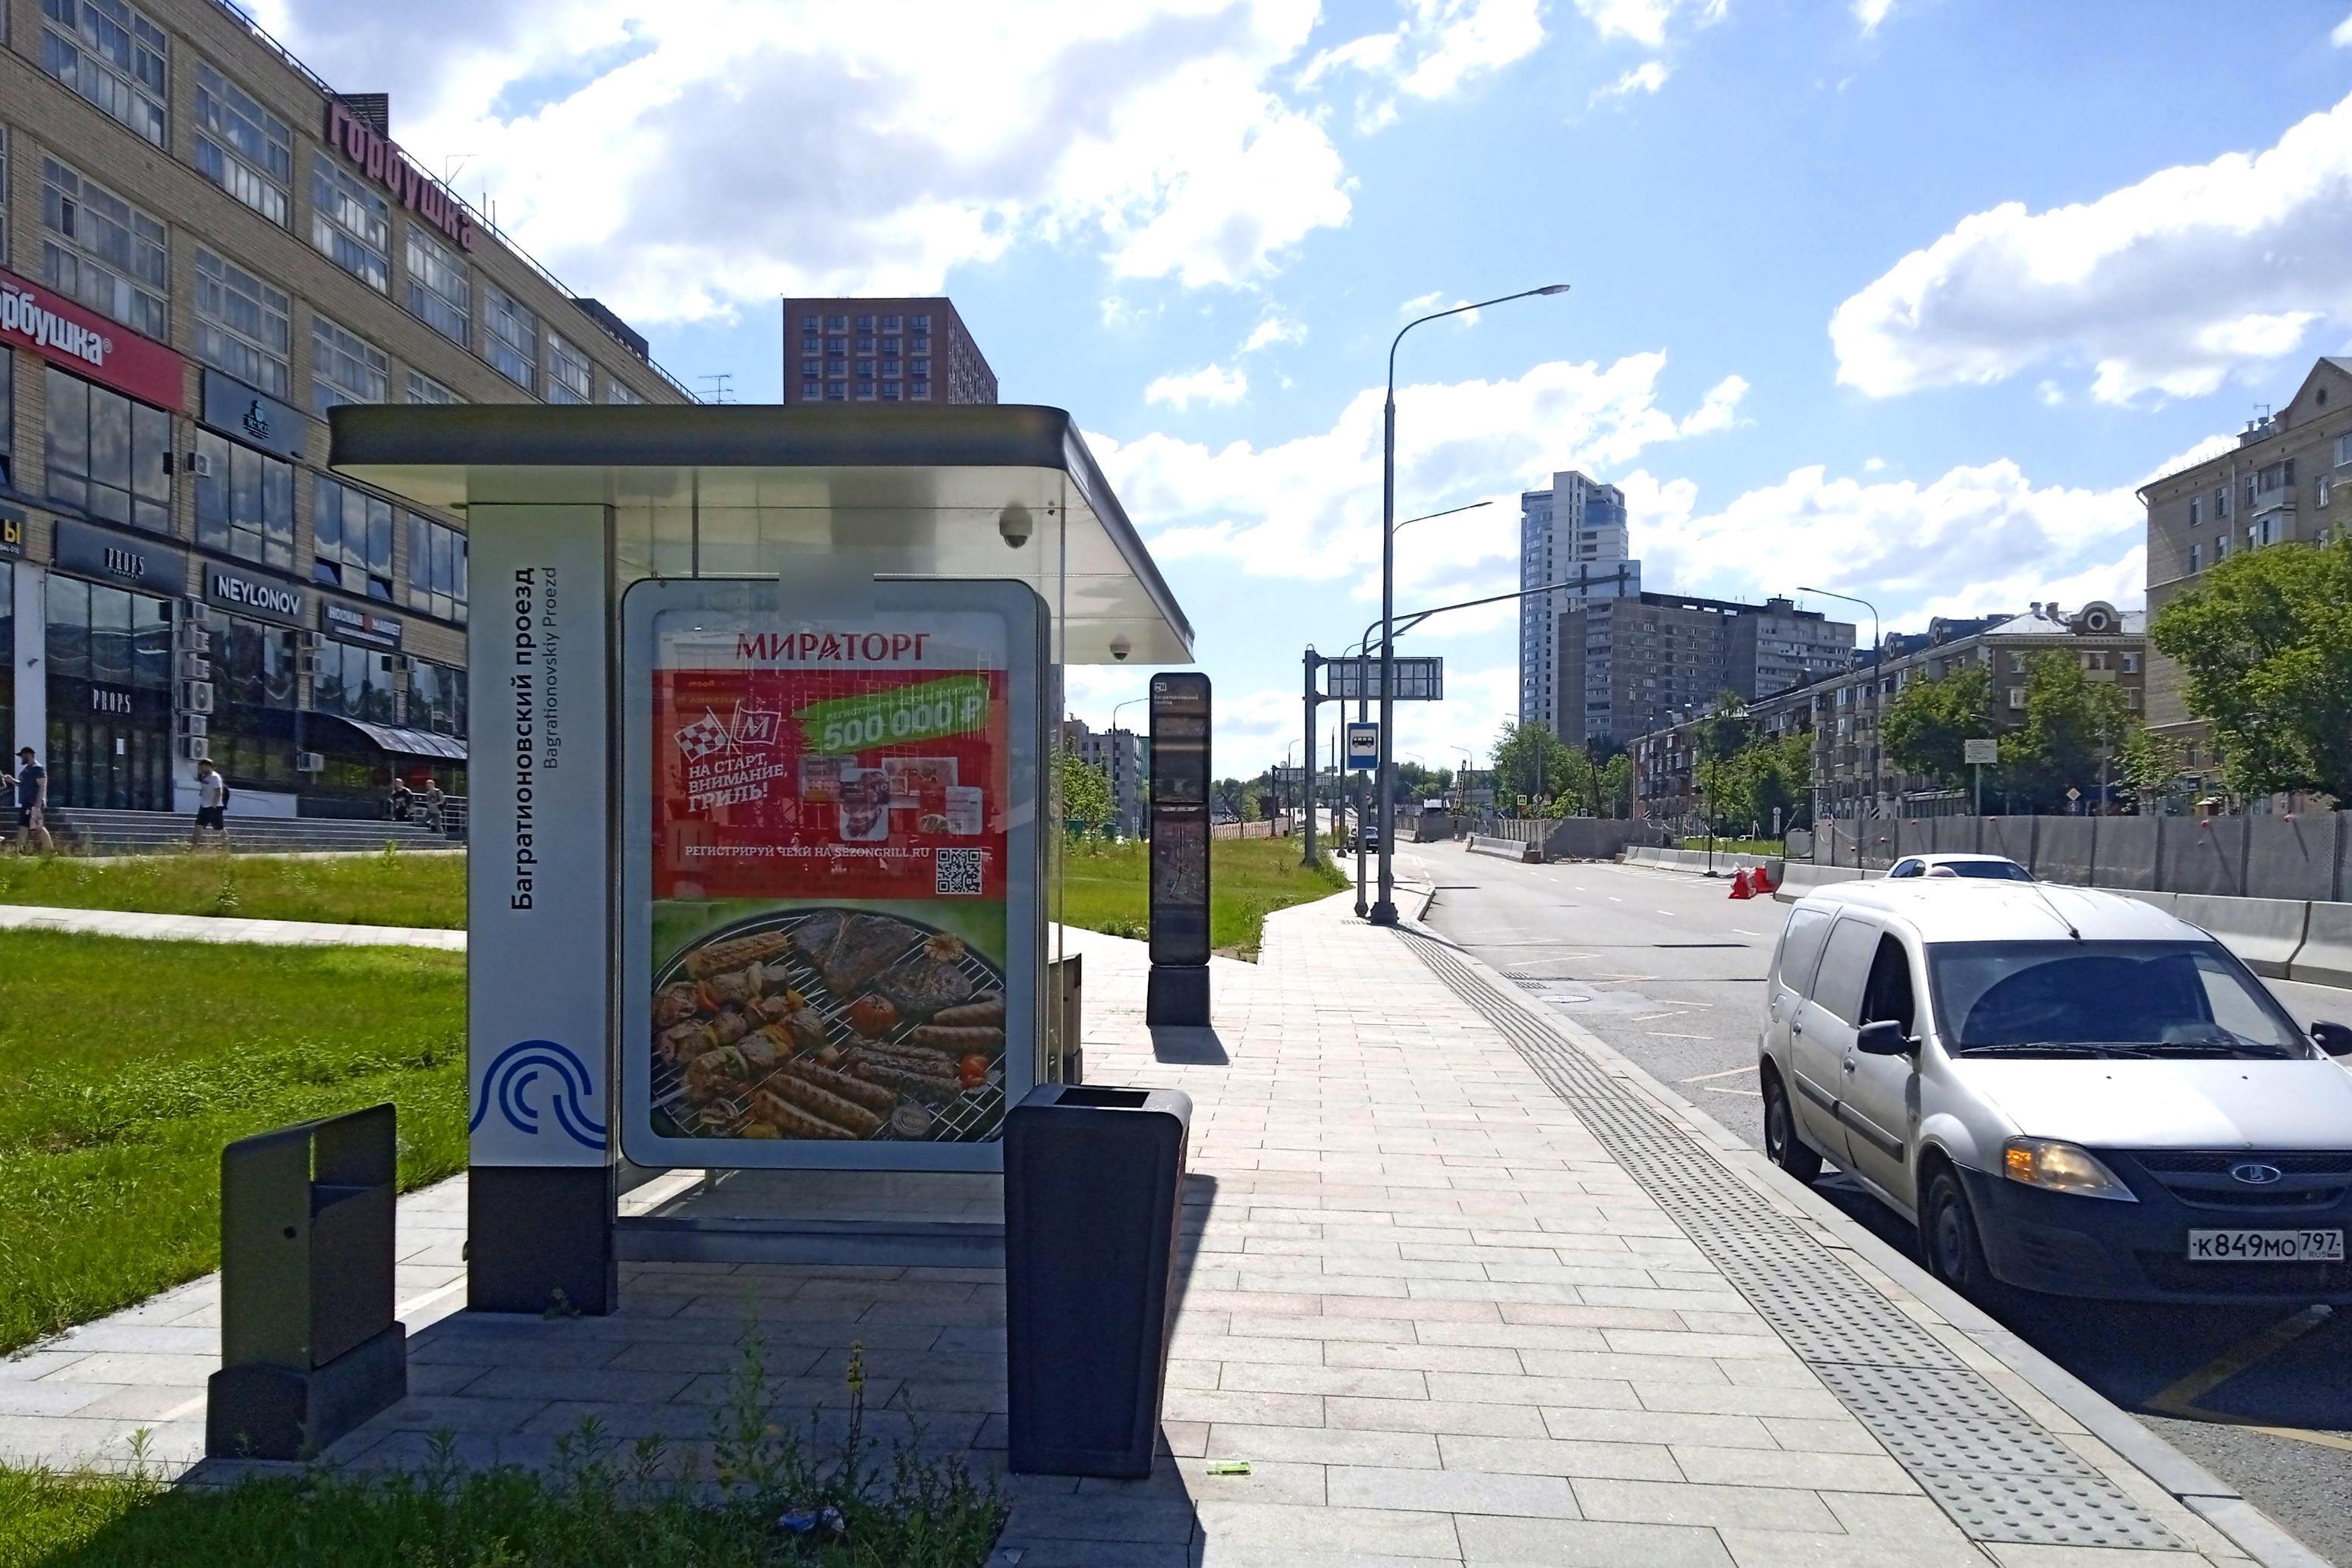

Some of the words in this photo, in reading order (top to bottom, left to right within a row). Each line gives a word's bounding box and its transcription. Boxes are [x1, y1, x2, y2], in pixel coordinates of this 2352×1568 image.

[0, 291, 102, 366] рбушка
[108, 548, 145, 575] PROPS
[219, 574, 300, 616] NEYLONOV
[541, 567, 557, 627] Proezd
[515, 567, 537, 665] проезд
[736, 633, 930, 661] МИРАТОРГ
[93, 688, 131, 713] PROPS
[542, 632, 561, 768] Bagrationovskiy
[823, 715, 884, 751] 500
[890, 700, 954, 737] 000
[688, 764, 711, 779] НА
[714, 753, 768, 774] СТАРТ,
[688, 763, 788, 794] ВНИМАНИЕ,
[511, 674, 538, 910] Багратионовский
[688, 781, 769, 812] ГРИЛЬ!
[685, 844, 775, 857] РЕГИСТРИРУЙ
[776, 846, 811, 857] ЧЕКИ
[814, 847, 832, 857] НА
[835, 847, 930, 858] SEZONGRILL.RU
[2198, 1233, 2297, 1257] К849МО
[2300, 1233, 2337, 1251] 797
